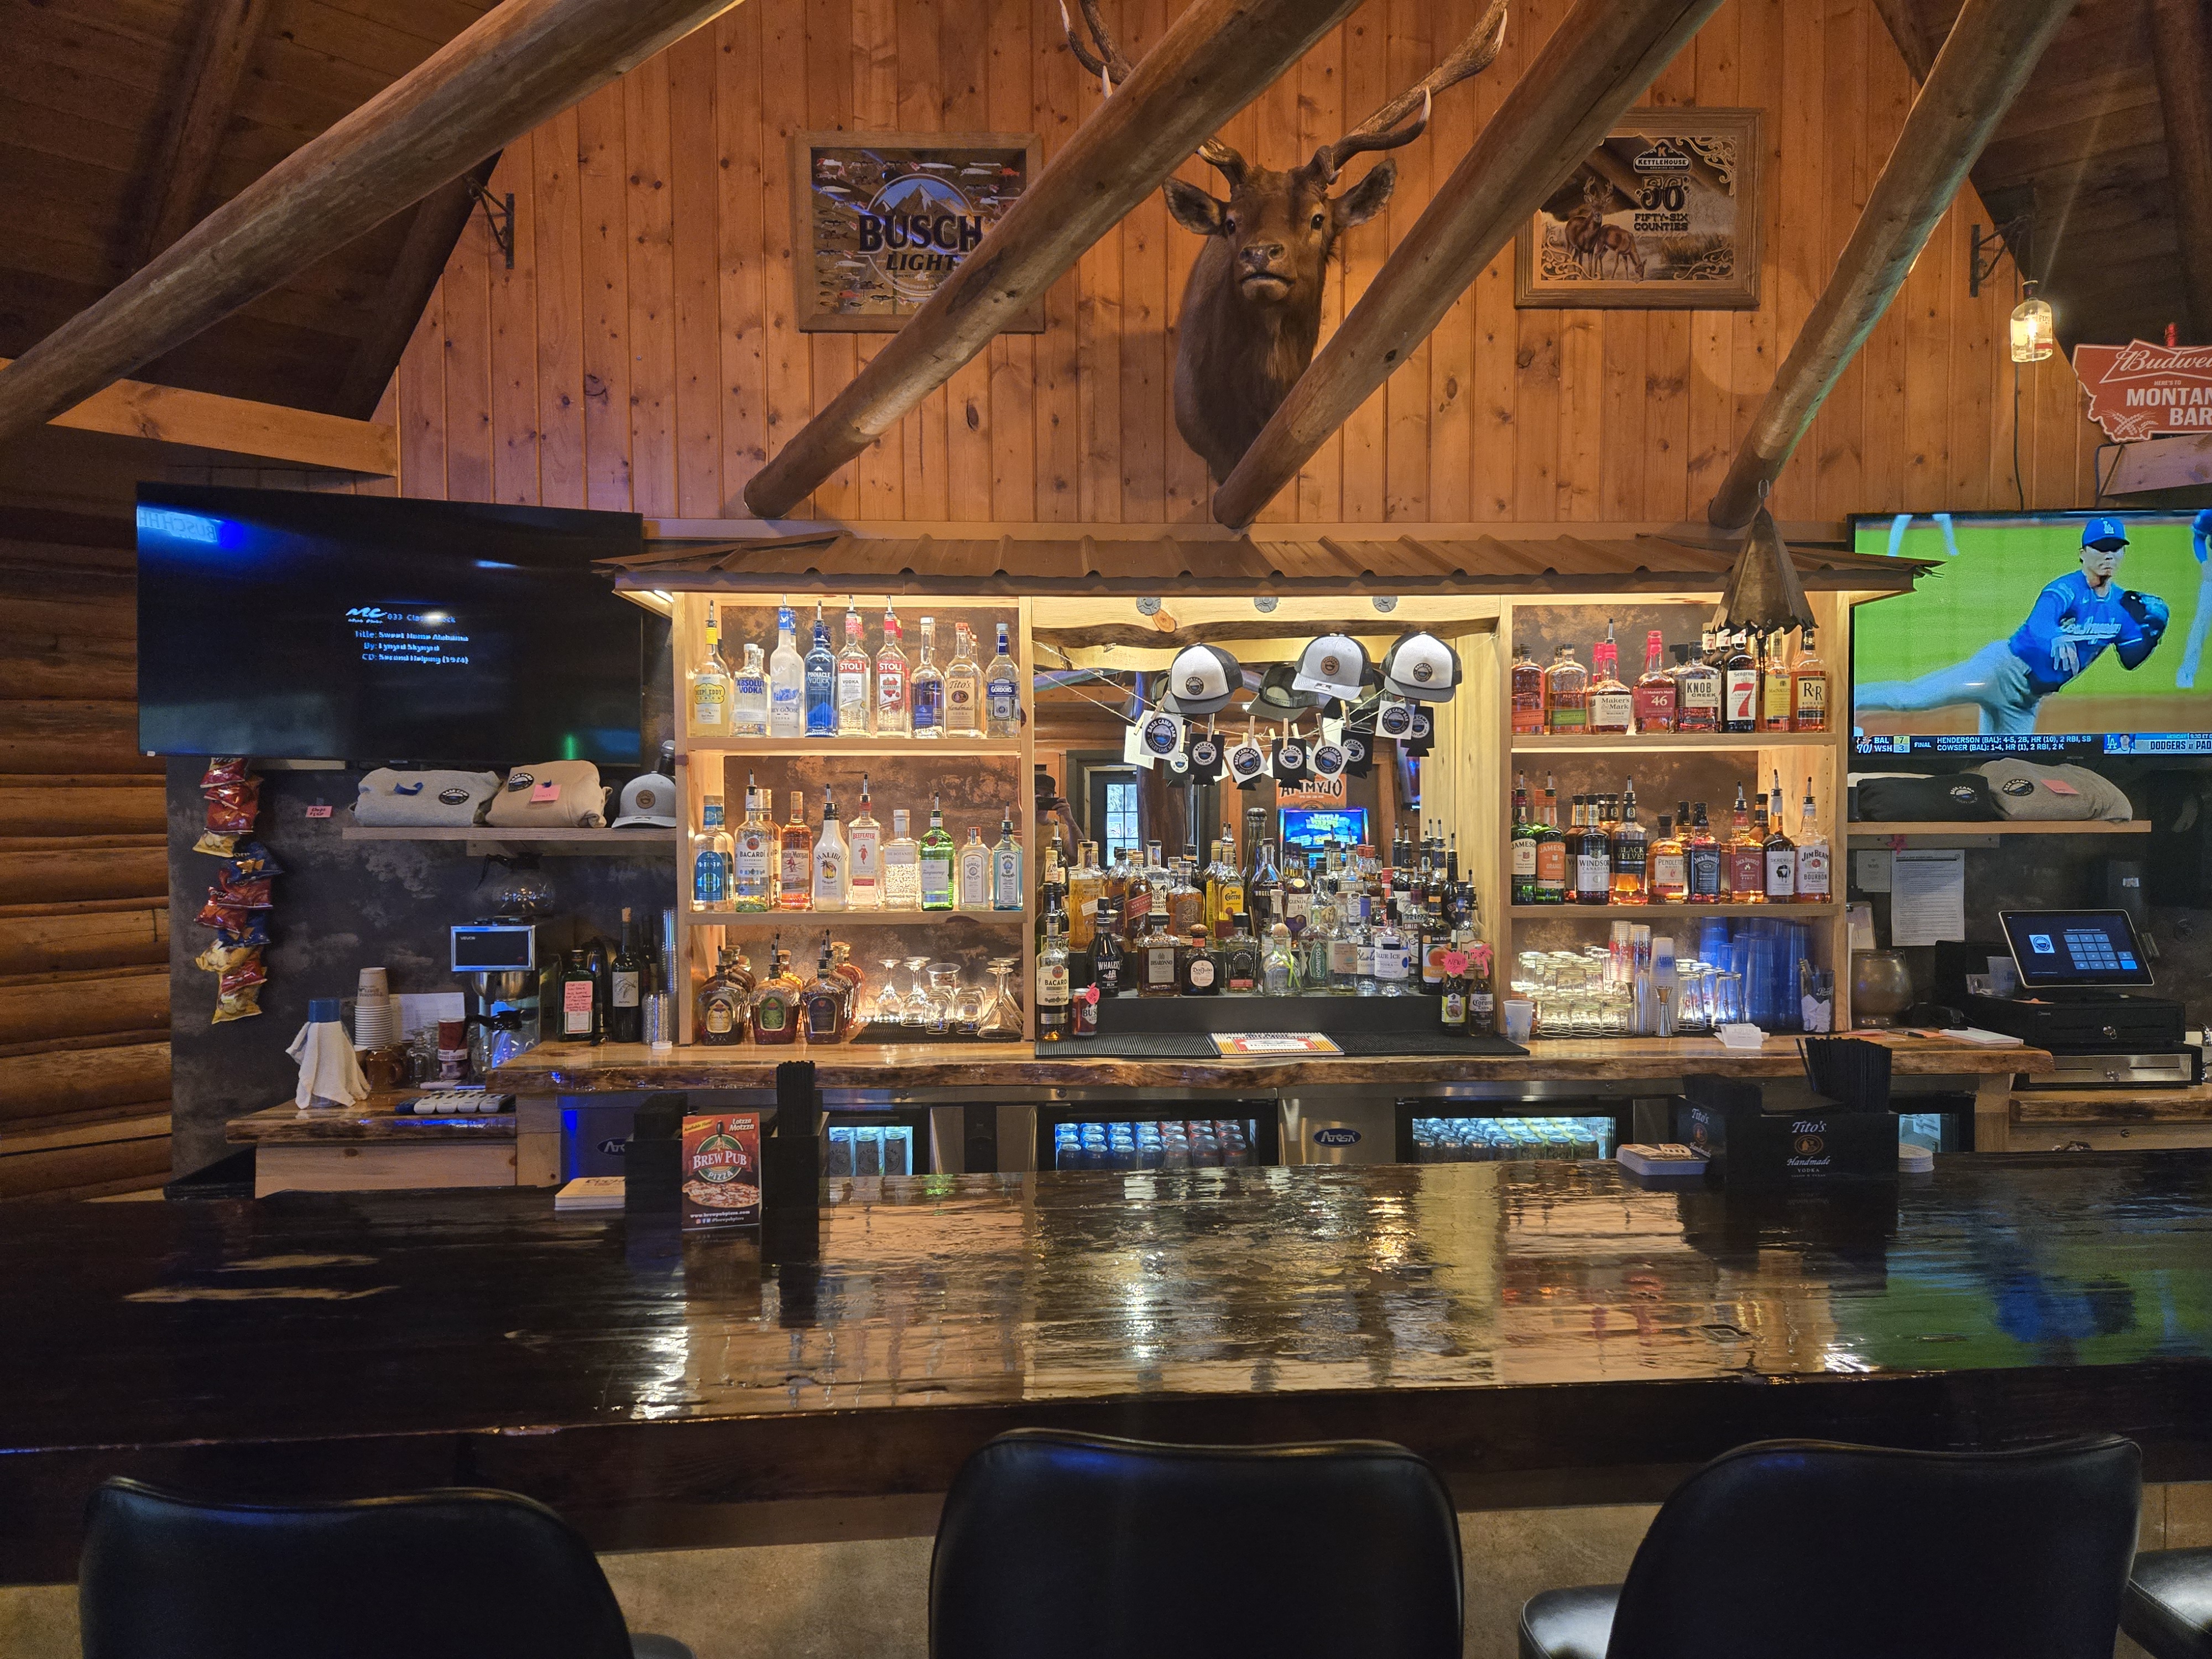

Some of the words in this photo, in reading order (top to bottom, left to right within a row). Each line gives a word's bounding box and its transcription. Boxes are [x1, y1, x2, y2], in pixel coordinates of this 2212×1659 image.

[1640, 176, 1684, 211] 56
[1634, 222, 1689, 231] COUNTIES
[858, 215, 982, 252] BUSCH
[885, 254, 959, 270] LIGHT
[1707, 638, 1714, 648] 7
[1724, 636, 1730, 644] 7
[879, 662, 902, 671] STOLI
[737, 679, 764, 687] ABSOLUT
[949, 680, 972, 689] Tito's
[1687, 682, 1712, 693] KNOB
[1651, 695, 1668, 706] 46
[1733, 682, 1755, 717] 7
[1384, 709, 1392, 719] BASE
[1417, 716, 1427, 724] CAMP
[1147, 721, 1158, 733] BASE
[1147, 738, 1160, 752] SEELEY
[1353, 740, 1363, 750] CAMP
[2107, 734, 2117, 749] LA
[2150, 740, 2186, 750] DODGERS
[1195, 743, 1205, 752] BASE
[1205, 742, 1215, 752] CAMP
[1290, 747, 1301, 755] CAMP
[1318, 748, 1328, 756] BASE
[1328, 747, 1339, 756] CAMP
[1238, 748, 1250, 758] CAMP
[1250, 749, 1258, 758] BAR
[1511, 840, 1536, 849] JAMESO
[792, 851, 808, 859] Morgan
[816, 852, 842, 863] MALIBU
[1694, 855, 1704, 864] JACK
[1802, 852, 1814, 861] JIM
[1814, 849, 1829, 860] BEAM
[1140, 898, 1152, 906] LABEL
[1225, 893, 1241, 901] Cuervo
[1233, 951, 1253, 961] HERRADURA
[1692, 1108, 1709, 1125] Tito's
[1791, 1120, 1827, 1134] Tito's
[1689, 1141, 1712, 1159] Handmade
[693, 1152, 724, 1170] BREW
[725, 1150, 747, 1165] PUB
[1786, 1156, 1830, 1166] Handmade
[708, 1170, 734, 1180] PIZZA
